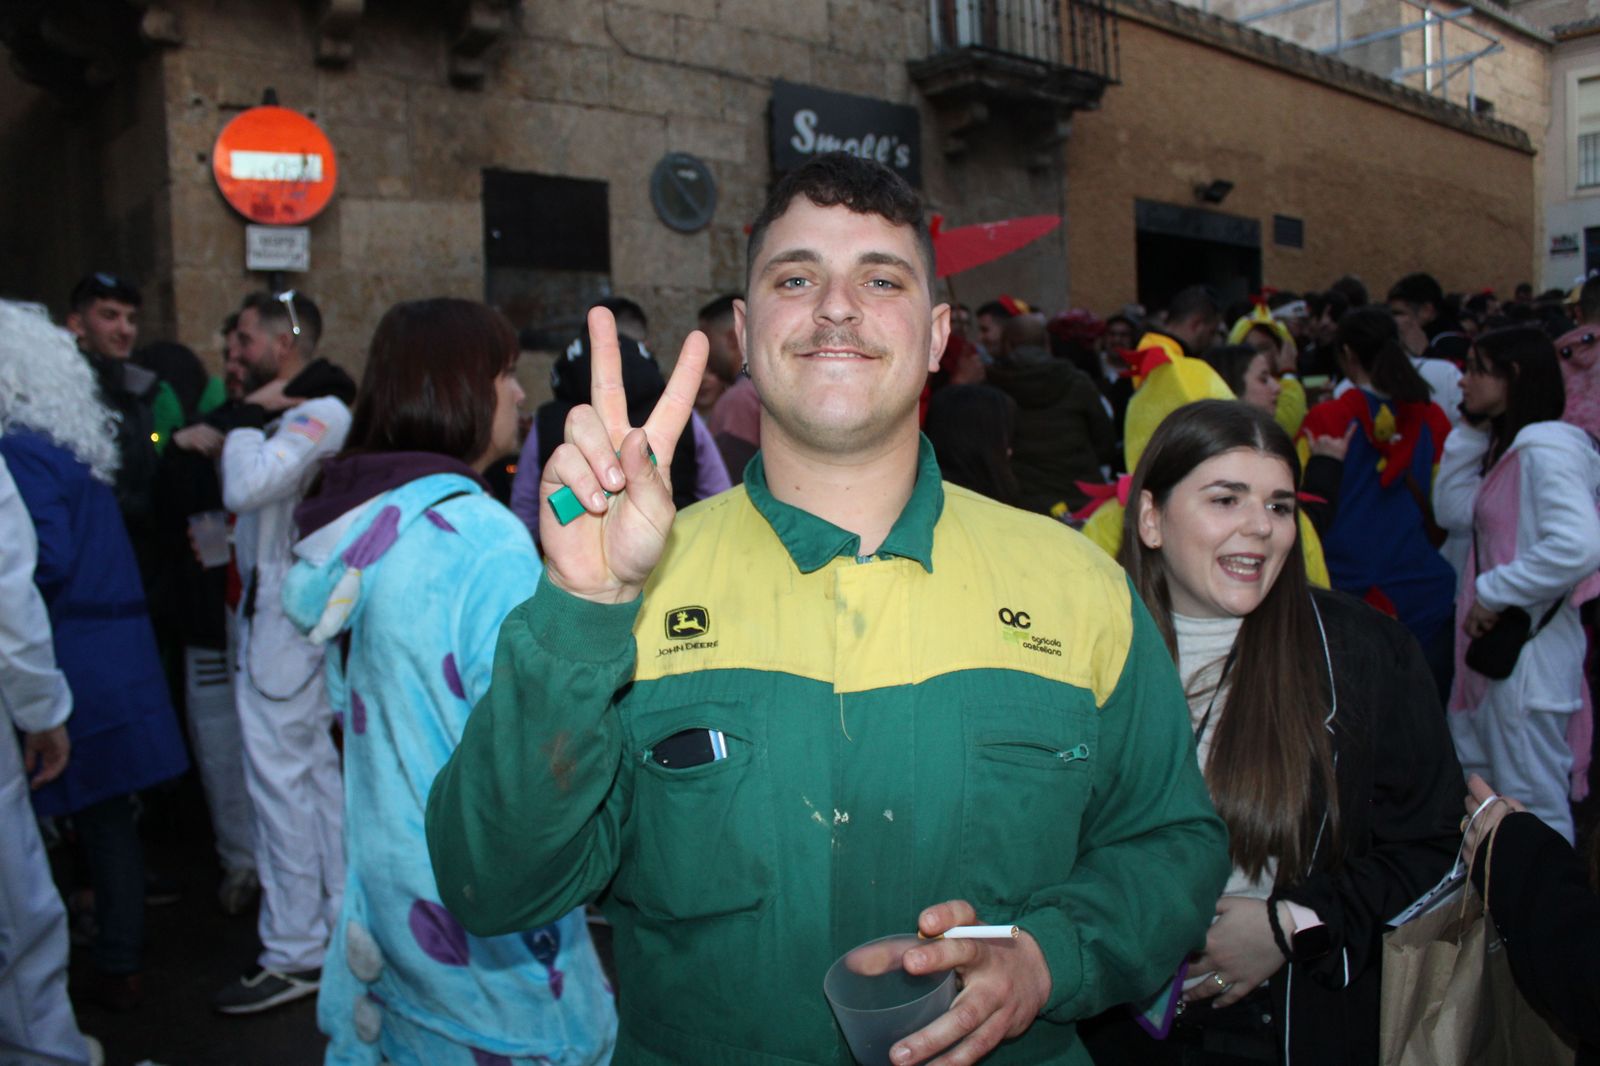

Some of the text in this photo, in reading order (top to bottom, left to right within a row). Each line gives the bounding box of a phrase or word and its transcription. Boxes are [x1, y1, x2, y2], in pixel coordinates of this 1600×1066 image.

[790, 109, 910, 168] Small's
[656, 640, 719, 658] JOHN DEERE
